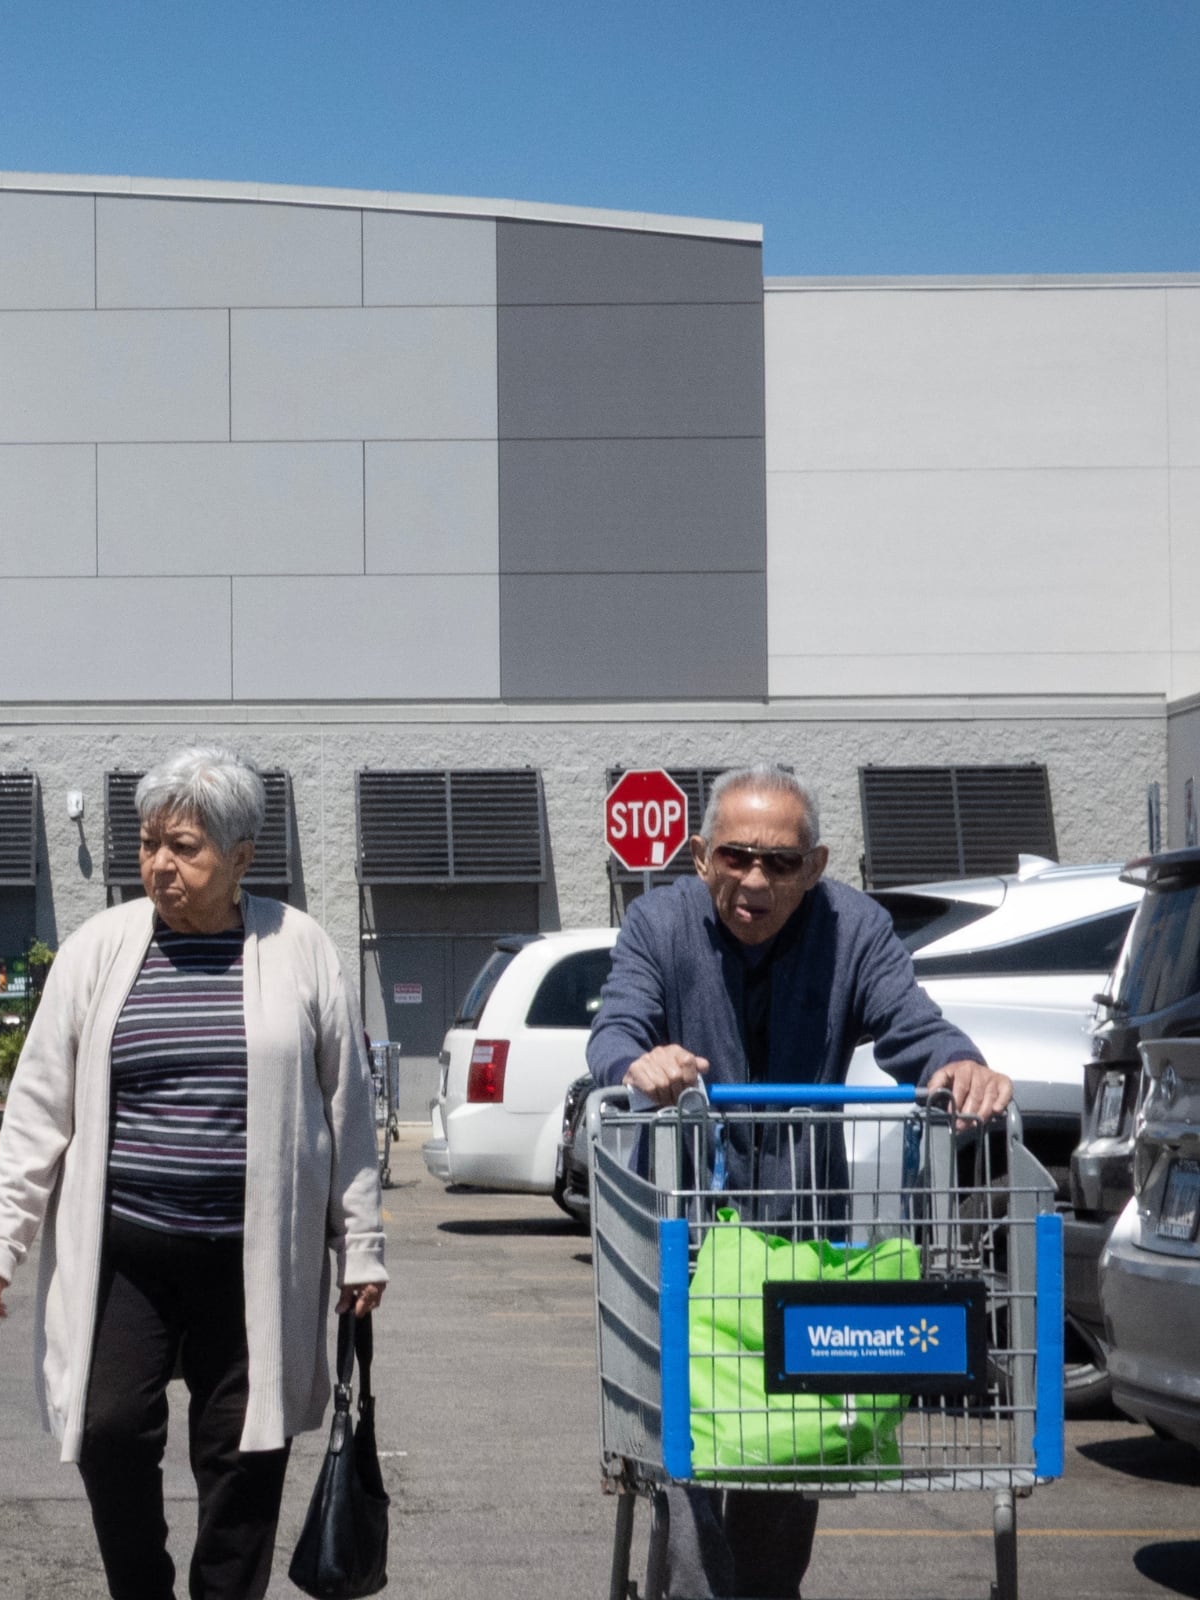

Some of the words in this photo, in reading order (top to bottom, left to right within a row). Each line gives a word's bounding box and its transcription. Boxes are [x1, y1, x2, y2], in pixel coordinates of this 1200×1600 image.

[610, 800, 681, 839] STOP
[807, 1325, 904, 1347] Walmart
[811, 1348, 829, 1357] Save
[830, 1348, 859, 1358] money.
[861, 1348, 878, 1357] Live
[879, 1348, 906, 1357] better.
